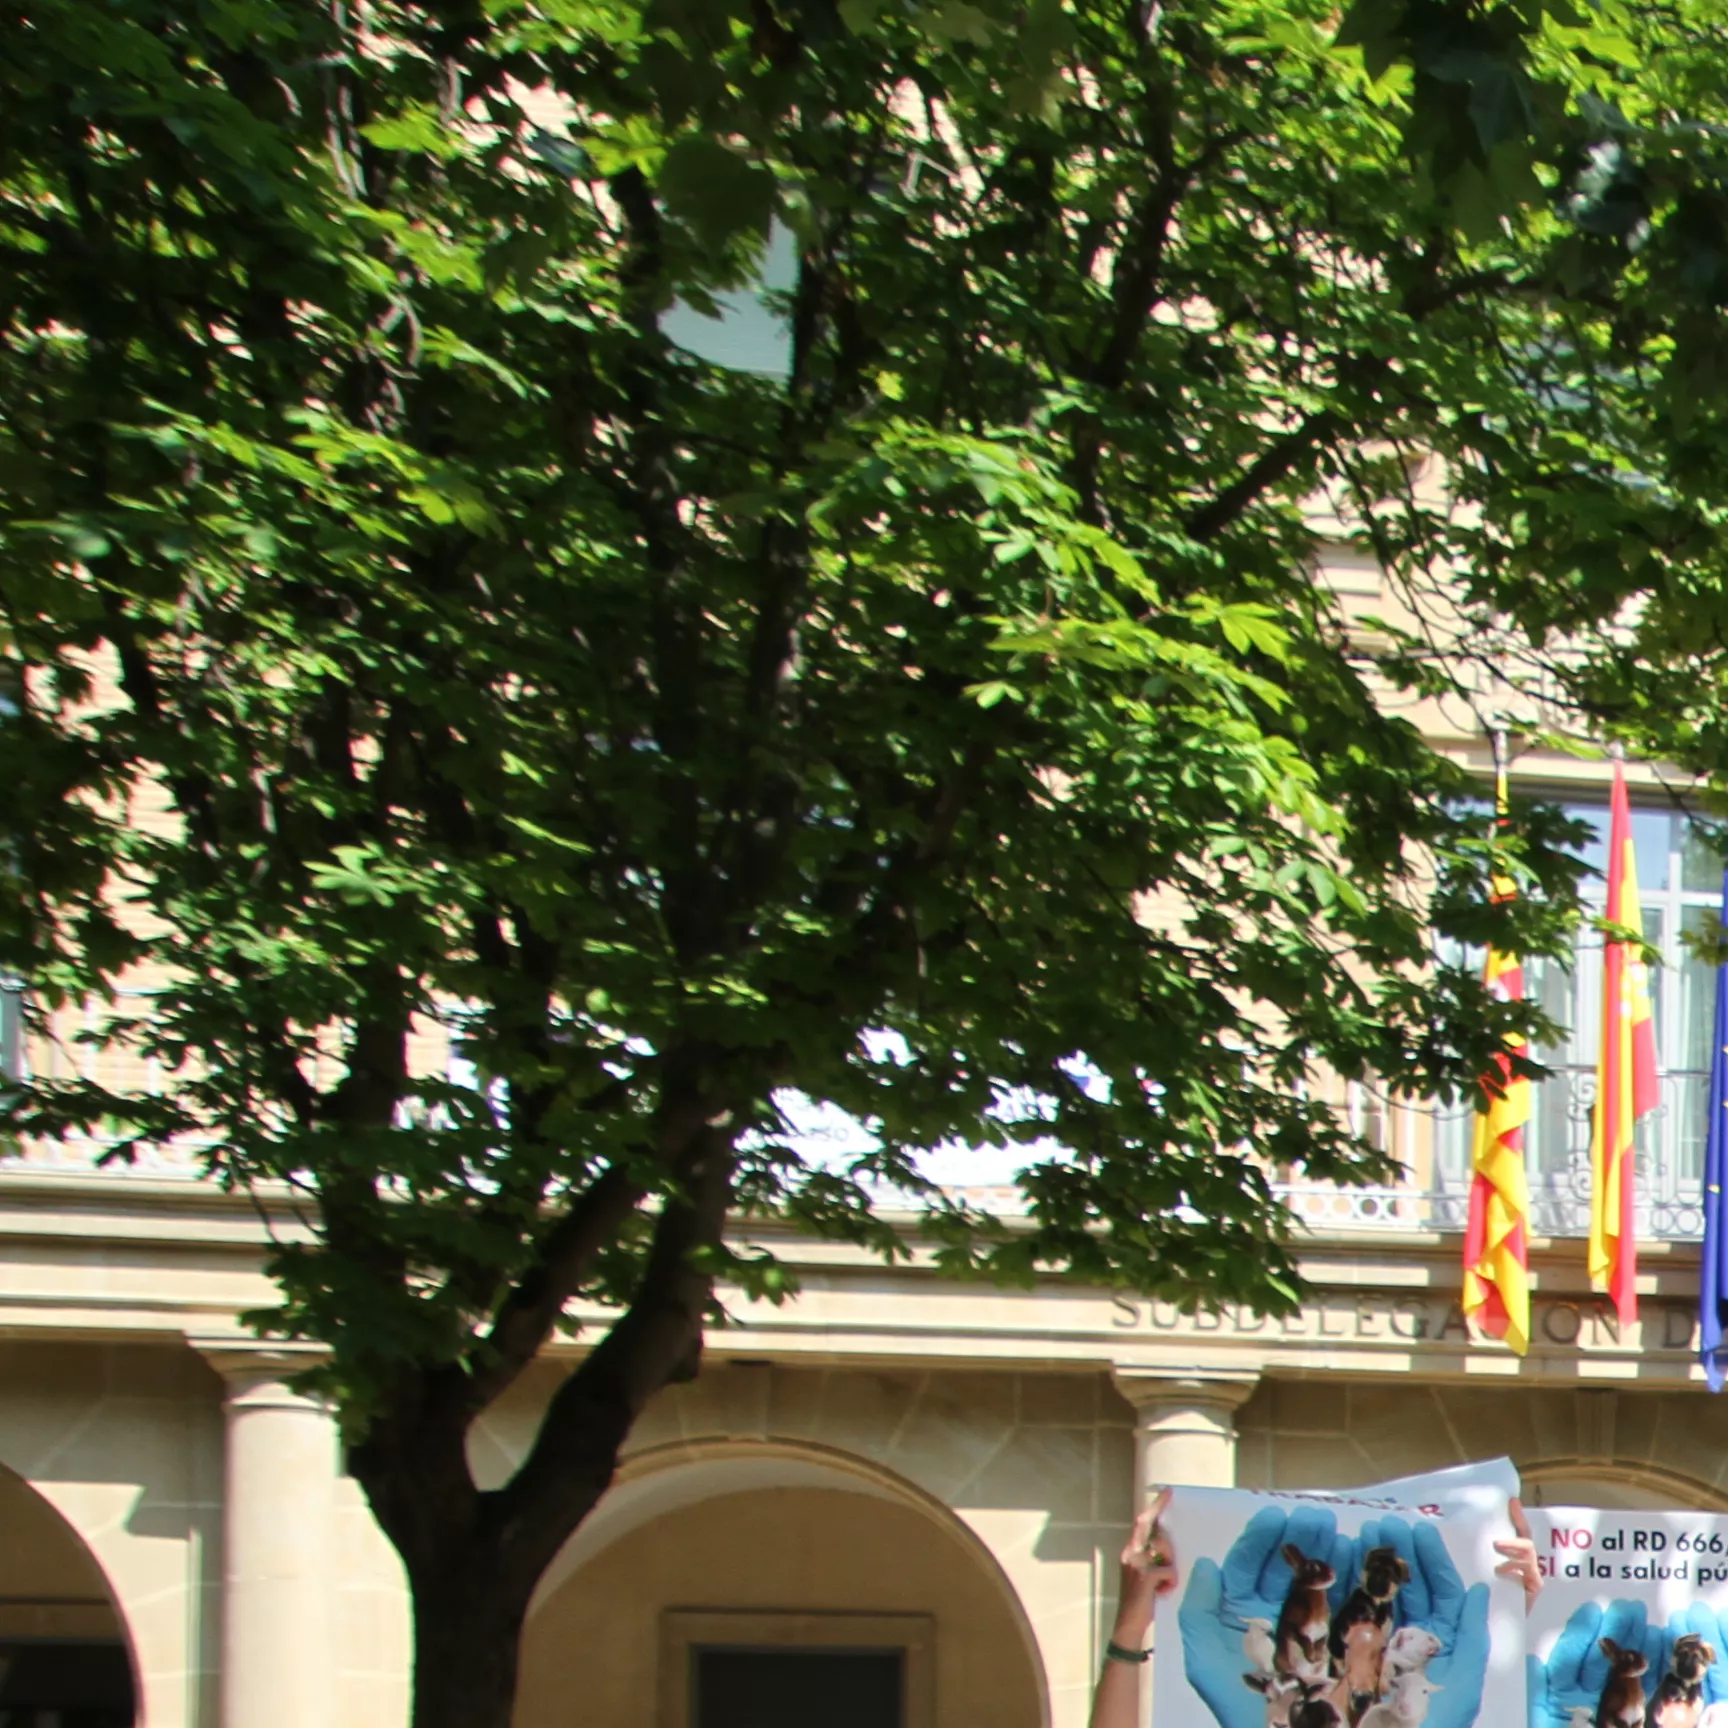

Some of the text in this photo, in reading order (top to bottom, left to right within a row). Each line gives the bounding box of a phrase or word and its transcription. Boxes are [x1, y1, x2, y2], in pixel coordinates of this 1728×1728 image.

[1111, 1295, 1629, 1347] SUBDELEGAON
[1550, 1528, 1593, 1550] NO
[1601, 1529, 1625, 1551] al
[1633, 1530, 1667, 1551] RD
[1565, 1564, 1580, 1578] a
[1589, 1557, 1611, 1579] la
[1621, 1558, 1689, 1581] salud
